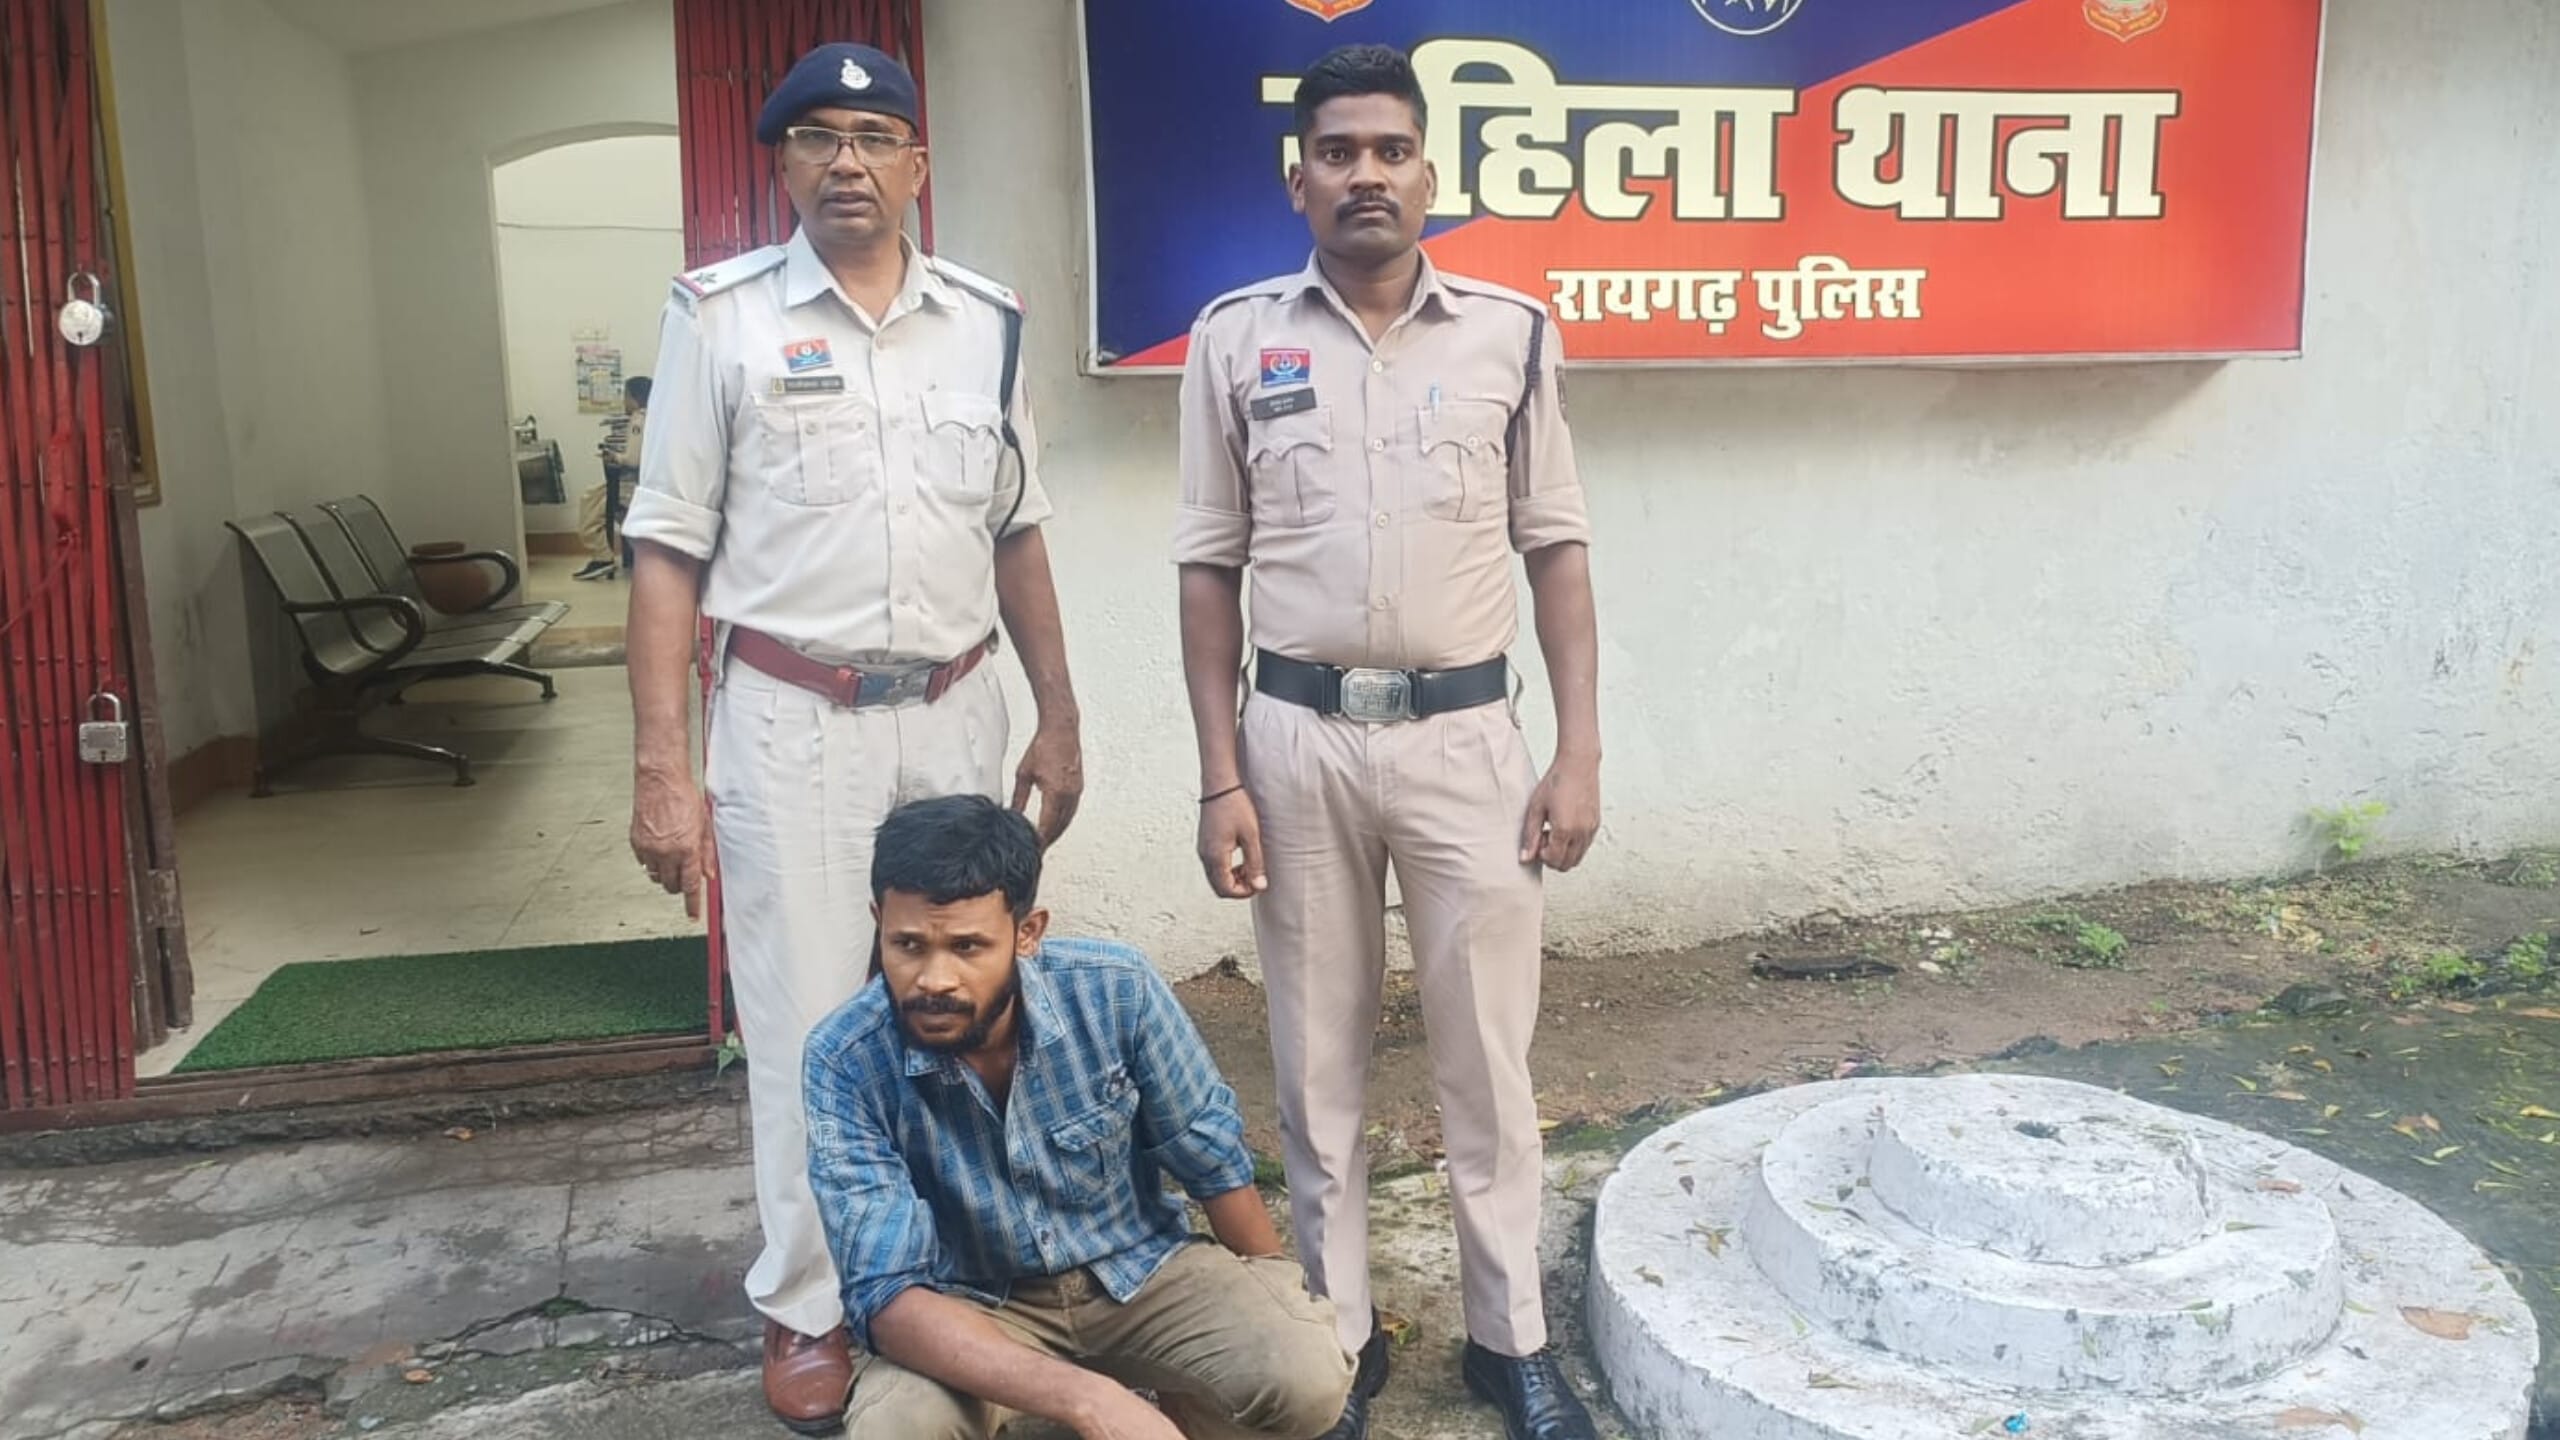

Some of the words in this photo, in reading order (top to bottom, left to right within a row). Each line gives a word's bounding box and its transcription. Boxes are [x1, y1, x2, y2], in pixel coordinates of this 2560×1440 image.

[1261, 38, 1797, 220] हिला
[1832, 84, 2181, 219] थाना
[1546, 270, 1742, 334] रायगढ़
[1752, 255, 1927, 339] पुलिस
